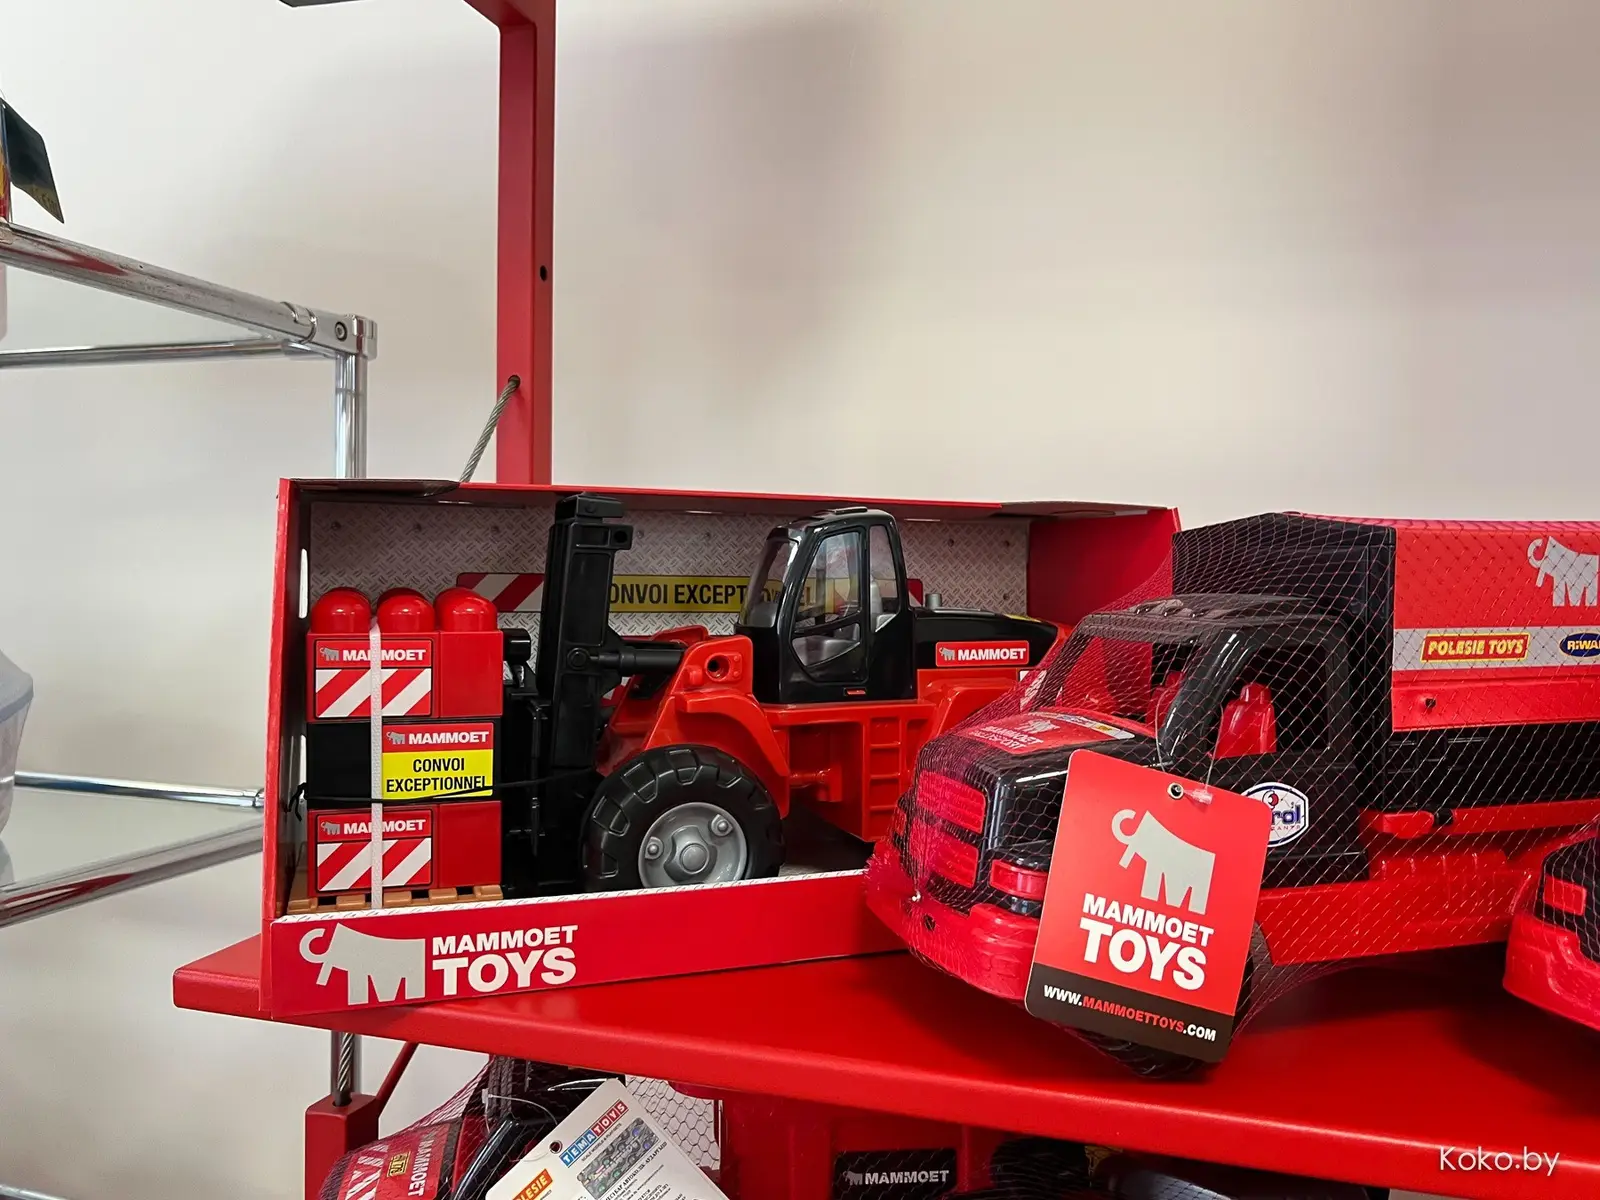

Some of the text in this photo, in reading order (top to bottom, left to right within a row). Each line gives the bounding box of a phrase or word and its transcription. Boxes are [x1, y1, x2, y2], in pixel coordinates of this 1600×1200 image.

[609, 583, 668, 604] ONVOI
[1428, 638, 1524, 656] POLESIE TOYS
[1567, 640, 1600, 650] RiWA
[342, 649, 427, 661] MAMOET
[958, 648, 1026, 661] MAMMOET
[408, 731, 490, 745] MAMMOET
[412, 757, 465, 773] CONVOI
[386, 775, 486, 793] EXCEPTIONNEL
[343, 818, 427, 835] MAMOET
[1083, 893, 1214, 947] MAMMOET
[433, 925, 578, 956] MAMMOET
[1079, 917, 1208, 991] TOYS
[432, 947, 577, 996] TOYS
[1043, 984, 1217, 1042] WWW.MAMMOETTOYS.COM
[864, 1170, 949, 1185] MAMMOET
[518, 1174, 548, 1200] LESIE
